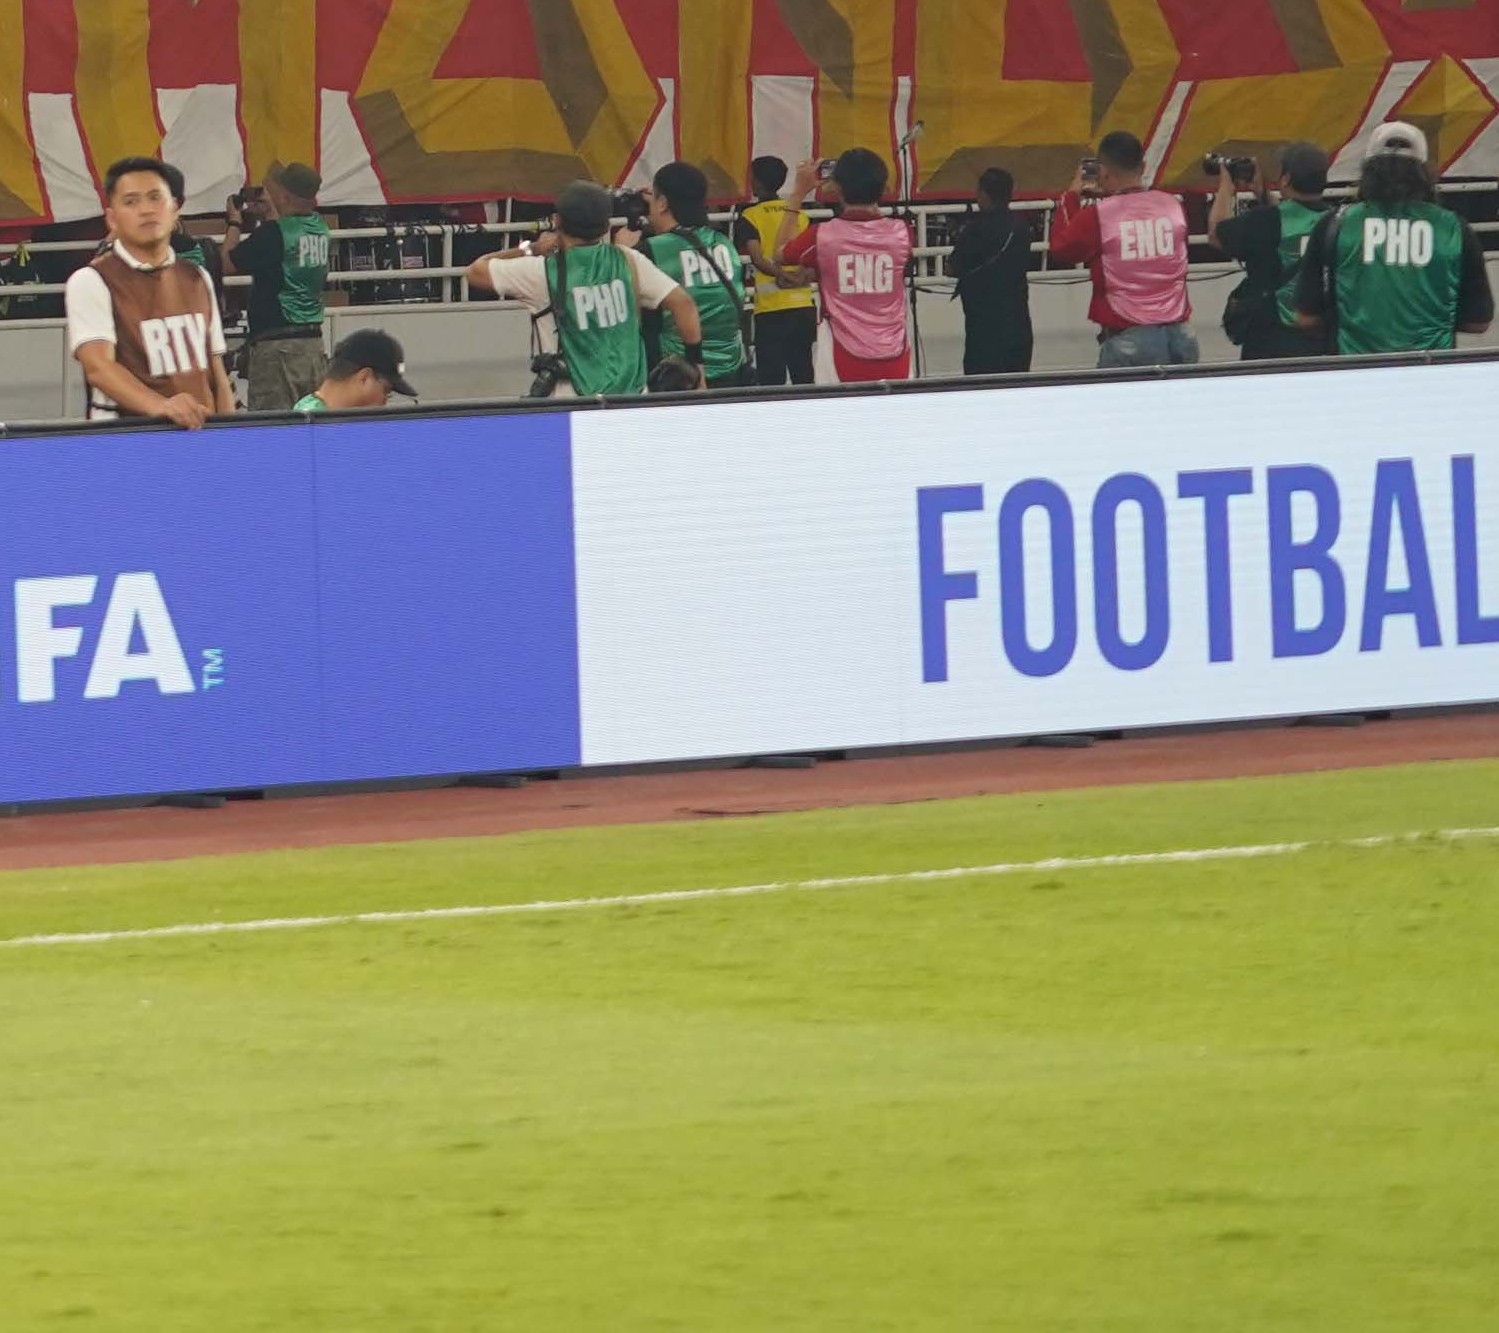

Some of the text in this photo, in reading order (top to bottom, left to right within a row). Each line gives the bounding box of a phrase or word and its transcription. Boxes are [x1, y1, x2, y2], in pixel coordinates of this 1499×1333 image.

[297, 233, 330, 269] PHO
[1119, 217, 1176, 261] ENG
[1362, 216, 1434, 268] PHO
[837, 253, 894, 294] ENG
[573, 278, 629, 332] PHO
[139, 312, 208, 378] RTV
[916, 453, 1499, 685] FOOTBAL
